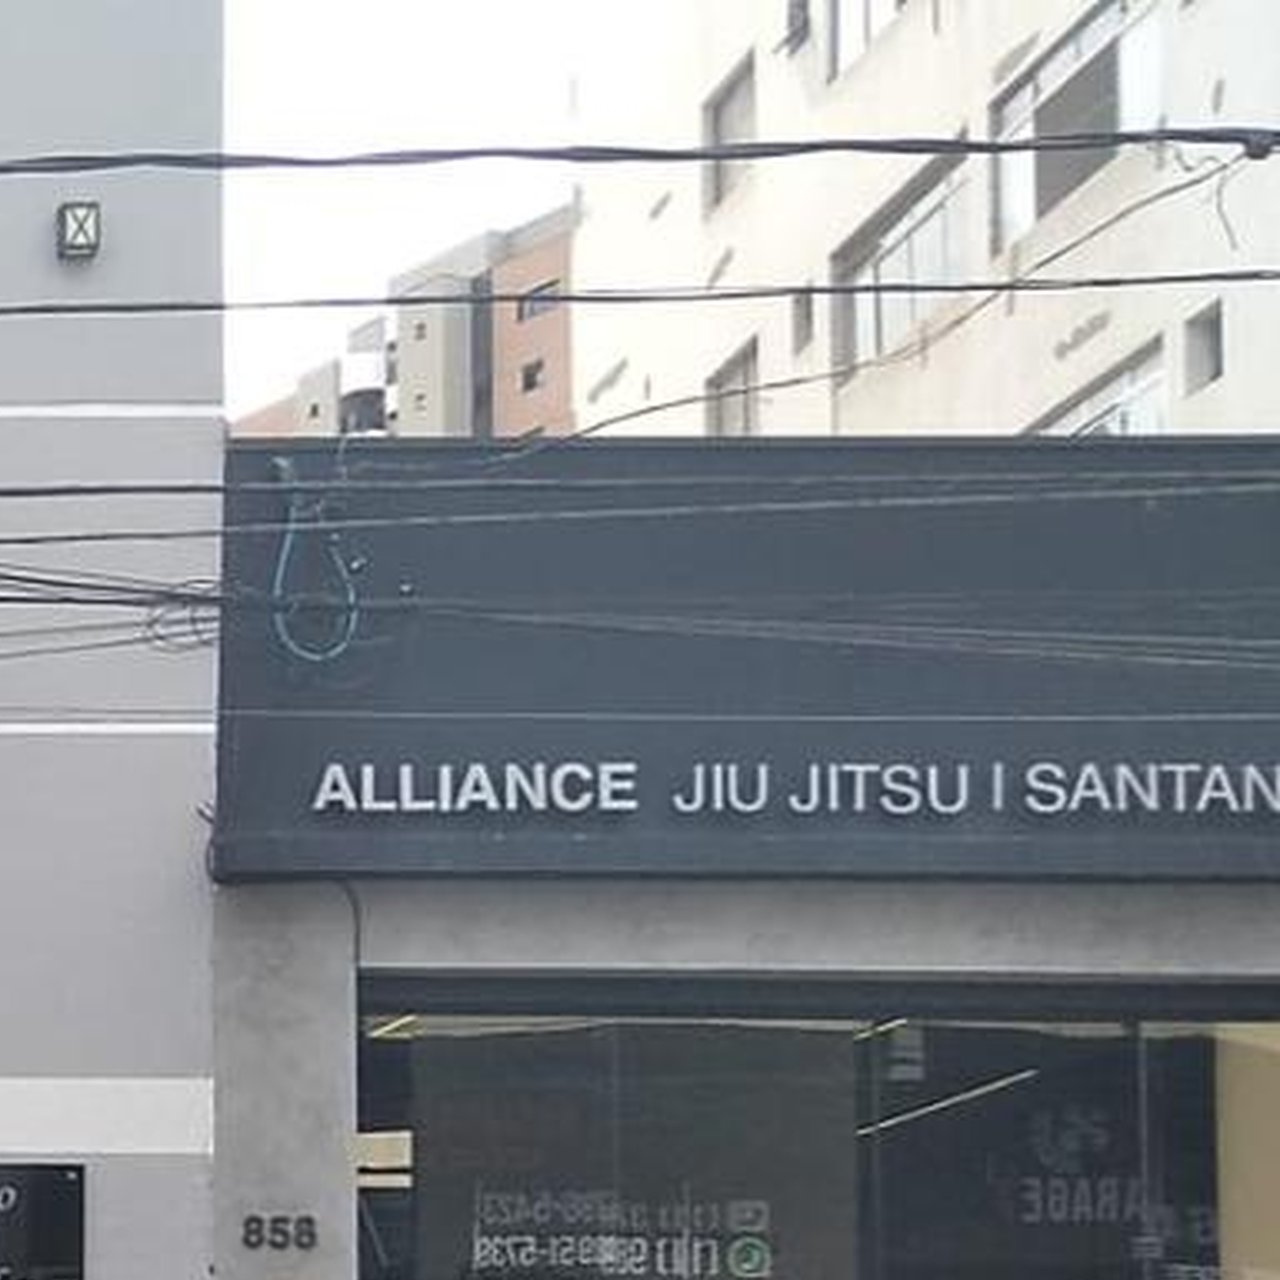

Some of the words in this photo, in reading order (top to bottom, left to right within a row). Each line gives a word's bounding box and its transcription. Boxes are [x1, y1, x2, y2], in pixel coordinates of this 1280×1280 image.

[313, 762, 639, 813] ALLIANCE
[672, 762, 769, 813] JIU
[788, 762, 970, 814] JITSU
[1025, 762, 1280, 814] SANTAN
[242, 1214, 317, 1250] 858
